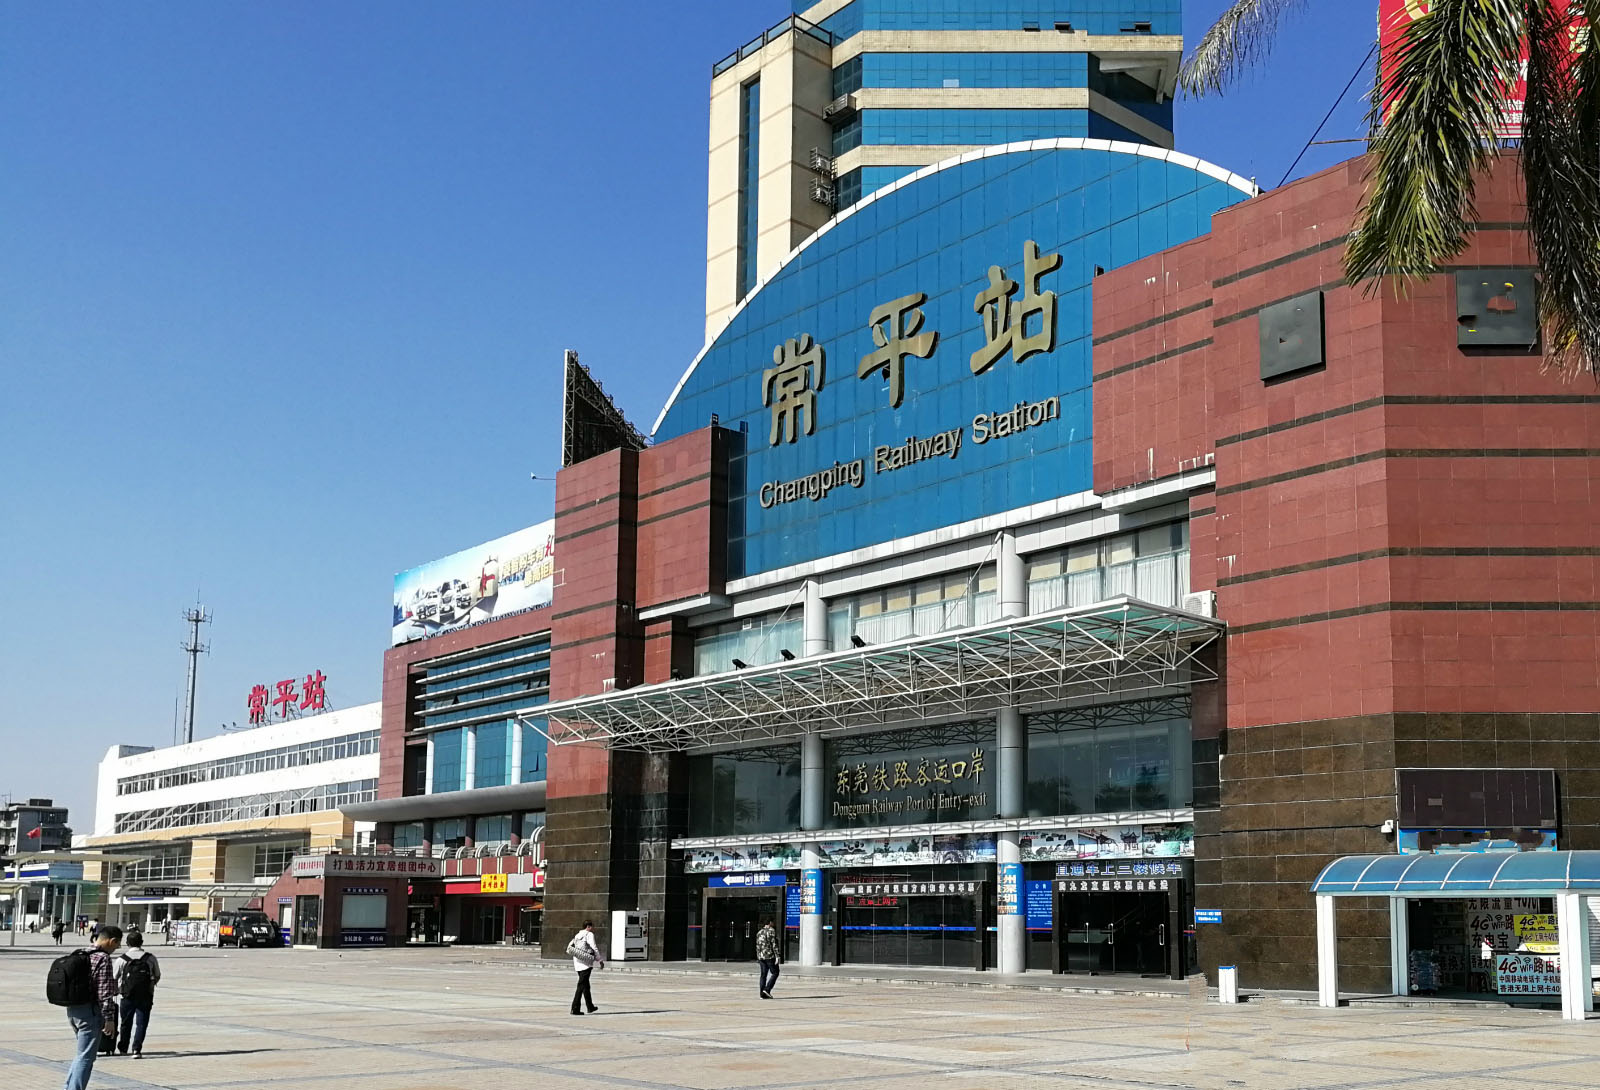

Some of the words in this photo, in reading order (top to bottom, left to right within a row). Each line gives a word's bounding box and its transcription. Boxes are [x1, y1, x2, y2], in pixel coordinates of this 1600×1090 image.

[762, 240, 1063, 445] 常平站
[759, 457, 863, 508] Changping
[874, 427, 961, 473] Railway
[971, 396, 1060, 444] Station
[248, 670, 327, 724] 常平站
[836, 747, 985, 795] 东莞铁路客运口岸
[833, 801, 870, 820] Dongguan
[872, 797, 905, 817] Railway
[906, 795, 925, 811] Port
[927, 793, 937, 809] of
[1470, 915, 1489, 931] 4G
[1472, 932, 1509, 949] 充电宝
[1499, 958, 1517, 974] 4G
[1499, 975, 1540, 984] 中国移动电话卡
[1500, 984, 1561, 993] 香港无限上网卡40
